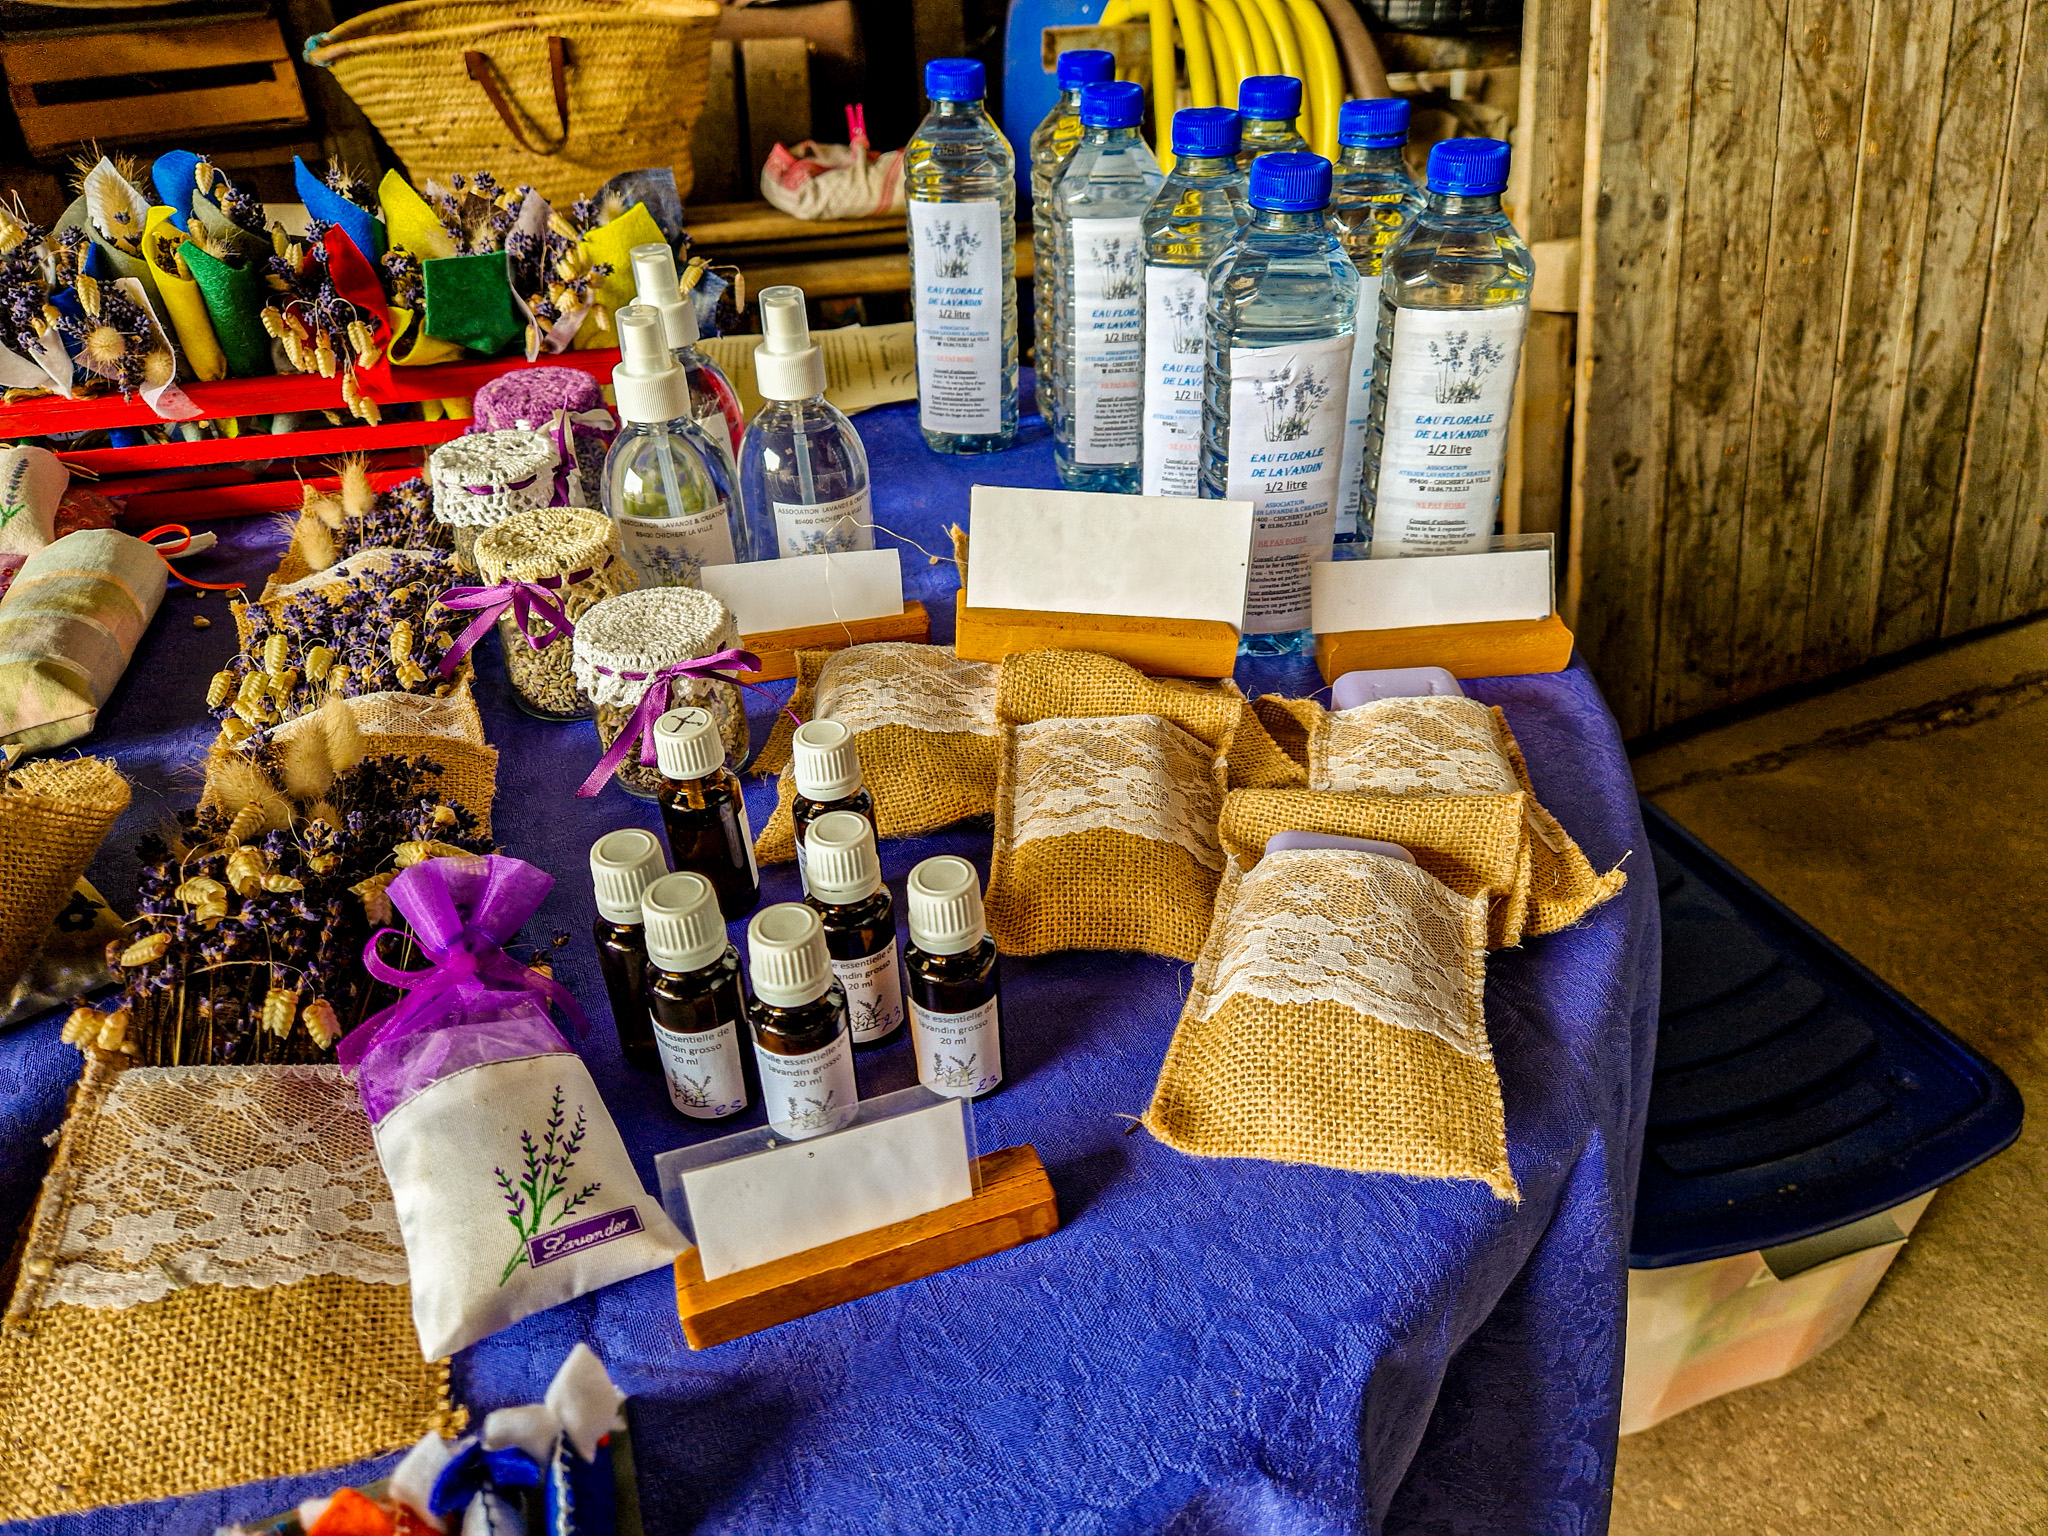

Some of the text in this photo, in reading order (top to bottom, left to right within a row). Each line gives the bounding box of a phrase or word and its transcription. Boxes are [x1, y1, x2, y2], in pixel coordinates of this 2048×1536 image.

[939, 310, 970, 319] 1/2 litre
[1104, 333, 1139, 343] 1/2 litre
[1162, 364, 1183, 372] EAU
[1174, 390, 1190, 401] 1/2
[1415, 414, 1494, 425] EAU FLORALE
[1414, 429, 1491, 439] DE LAVANDIN
[1250, 447, 1325, 462] EAU FLORALE
[1427, 444, 1472, 456] 1/2 litre
[1251, 462, 1323, 477] DE LAVANDIN
[1265, 481, 1308, 493] 1/2 litre
[822, 504, 848, 513] LAVANDE
[1265, 500, 1305, 508] ASSOCIATION
[621, 518, 658, 528] ASSOCIATION
[662, 520, 693, 528] LAVANDE
[697, 524, 713, 532] VILLE
[840, 951, 886, 970] essentielle
[865, 960, 890, 978] grosso
[862, 979, 873, 988] ml
[932, 1011, 982, 1024] essentielle
[984, 1003, 993, 1013] de
[918, 1018, 988, 1035] lavandin grosso
[665, 1027, 729, 1044] essentielle de
[689, 1043, 722, 1056] grosso
[673, 1054, 684, 1063] 20
[784, 1046, 836, 1066] essentielle
[768, 1053, 842, 1076] lavandin grosso
[810, 1076, 822, 1085] ml
